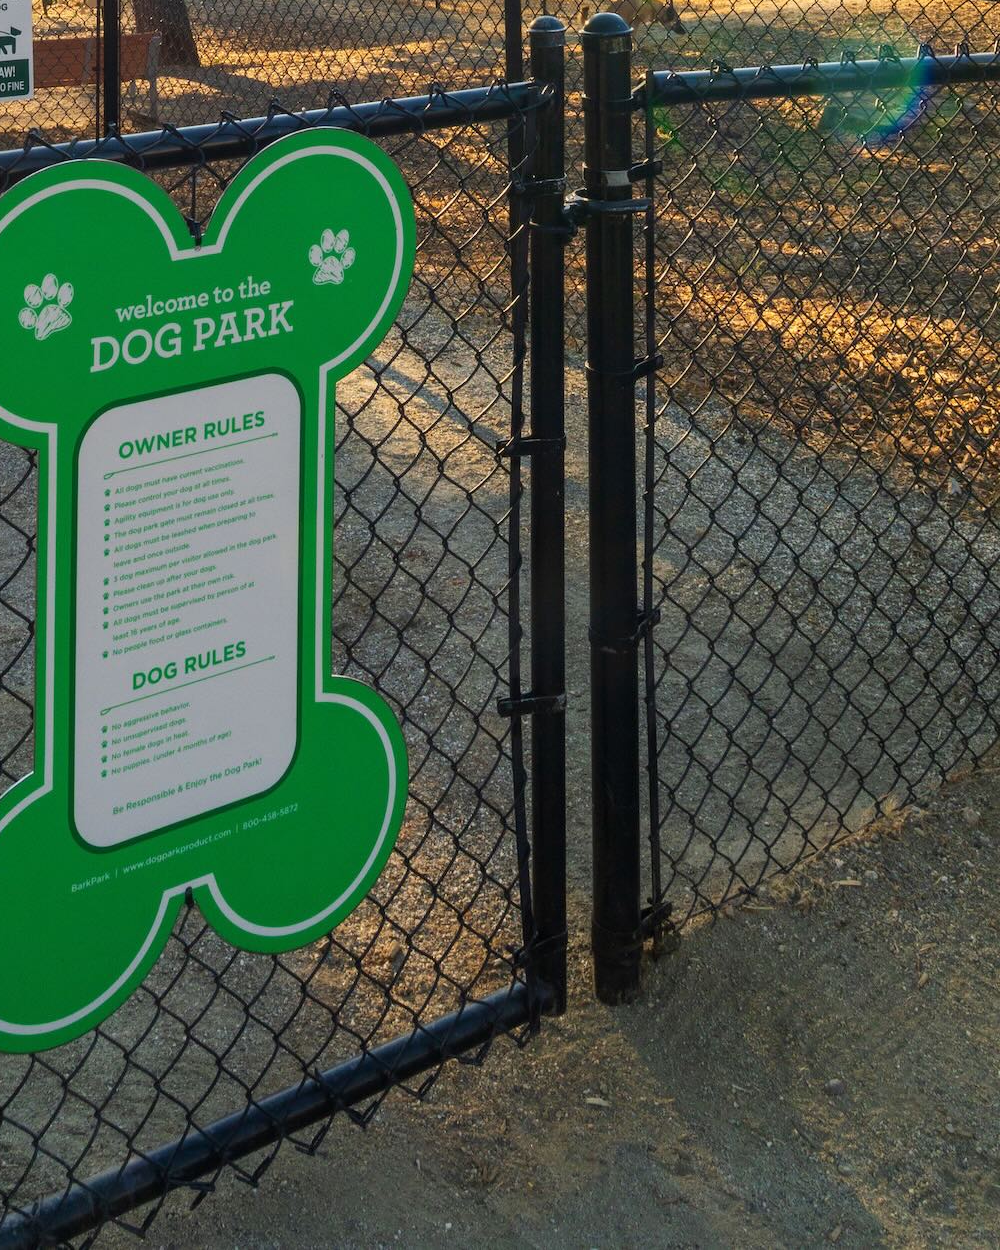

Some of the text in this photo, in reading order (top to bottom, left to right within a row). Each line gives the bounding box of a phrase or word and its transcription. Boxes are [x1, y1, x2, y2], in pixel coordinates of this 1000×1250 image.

[8, 81, 24, 91] FINE
[116, 276, 270, 322] welcome to the
[91, 301, 293, 372] DOG PARK
[119, 411, 264, 459] OWNER RULES
[133, 641, 246, 690] DOG RULES
[112, 758, 262, 815] Be Responsible & Enjoy the Dog Park!
[72, 873, 109, 892] BarkPark
